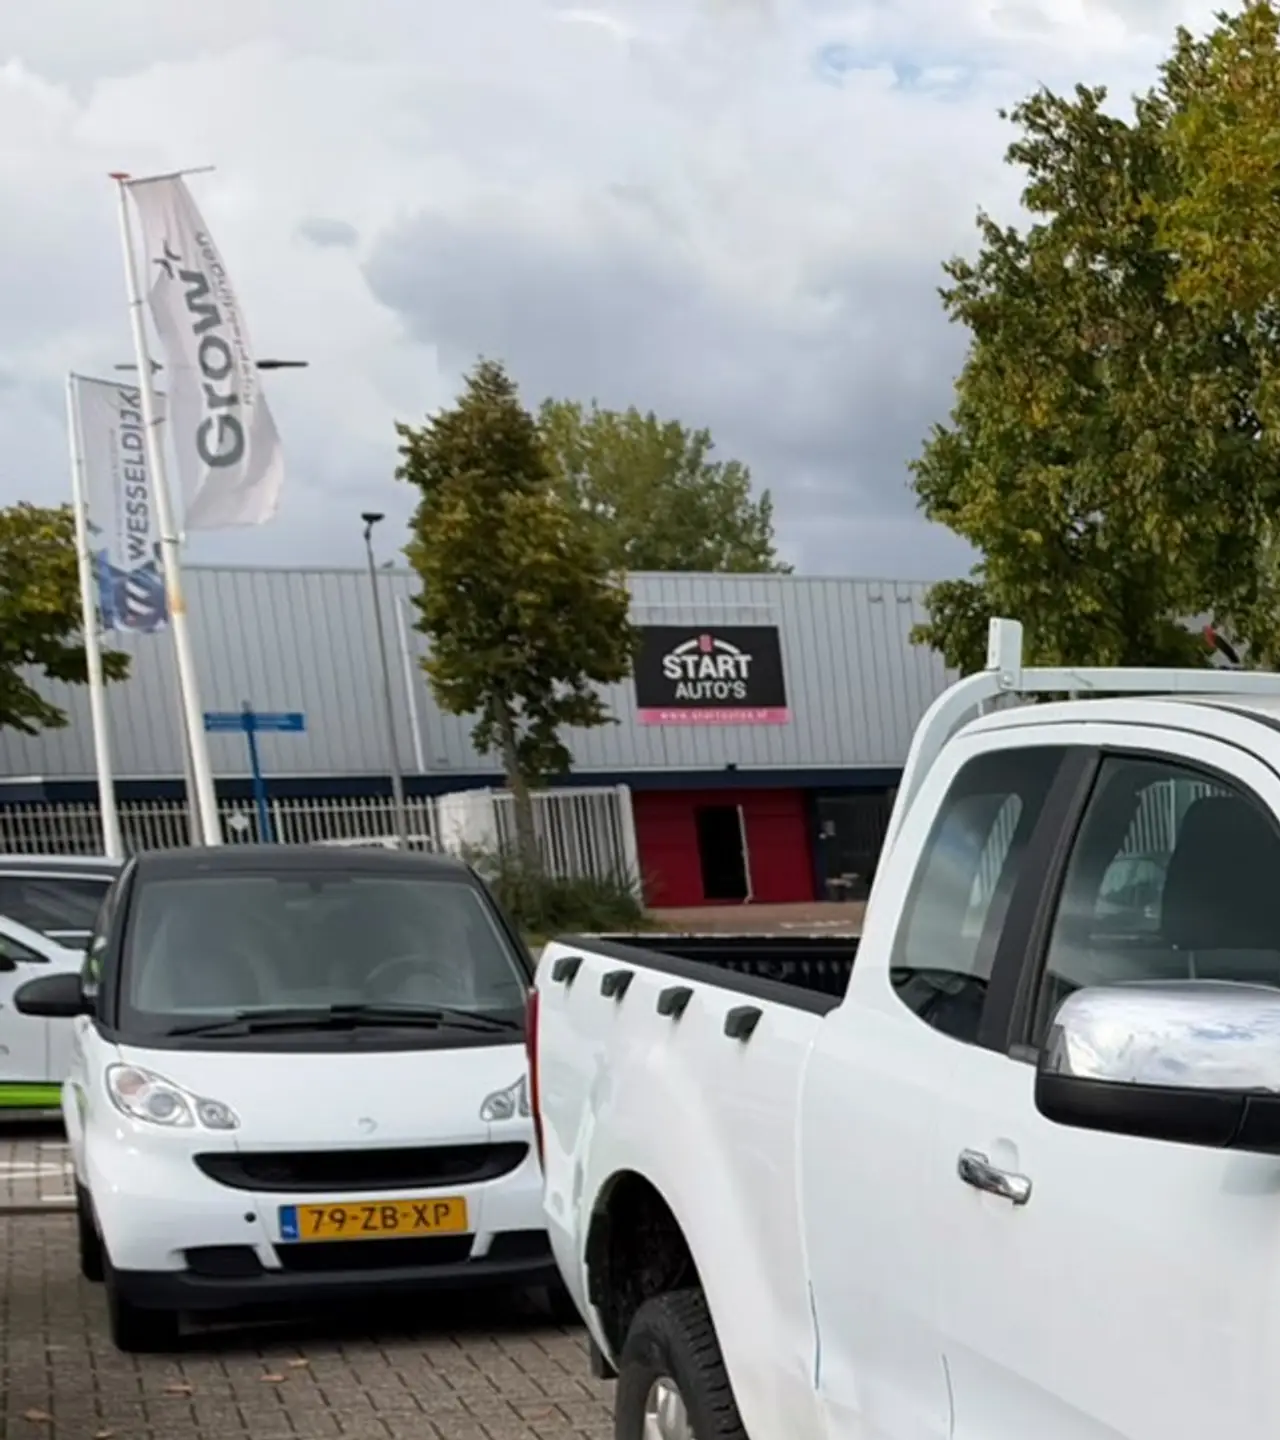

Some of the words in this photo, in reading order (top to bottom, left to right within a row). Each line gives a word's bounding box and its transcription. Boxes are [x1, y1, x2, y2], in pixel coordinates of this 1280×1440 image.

[179, 268, 245, 468] Grow
[662, 654, 752, 680] START
[675, 681, 746, 700] AUTO'S
[309, 1202, 450, 1234] 79-ZB-XP
